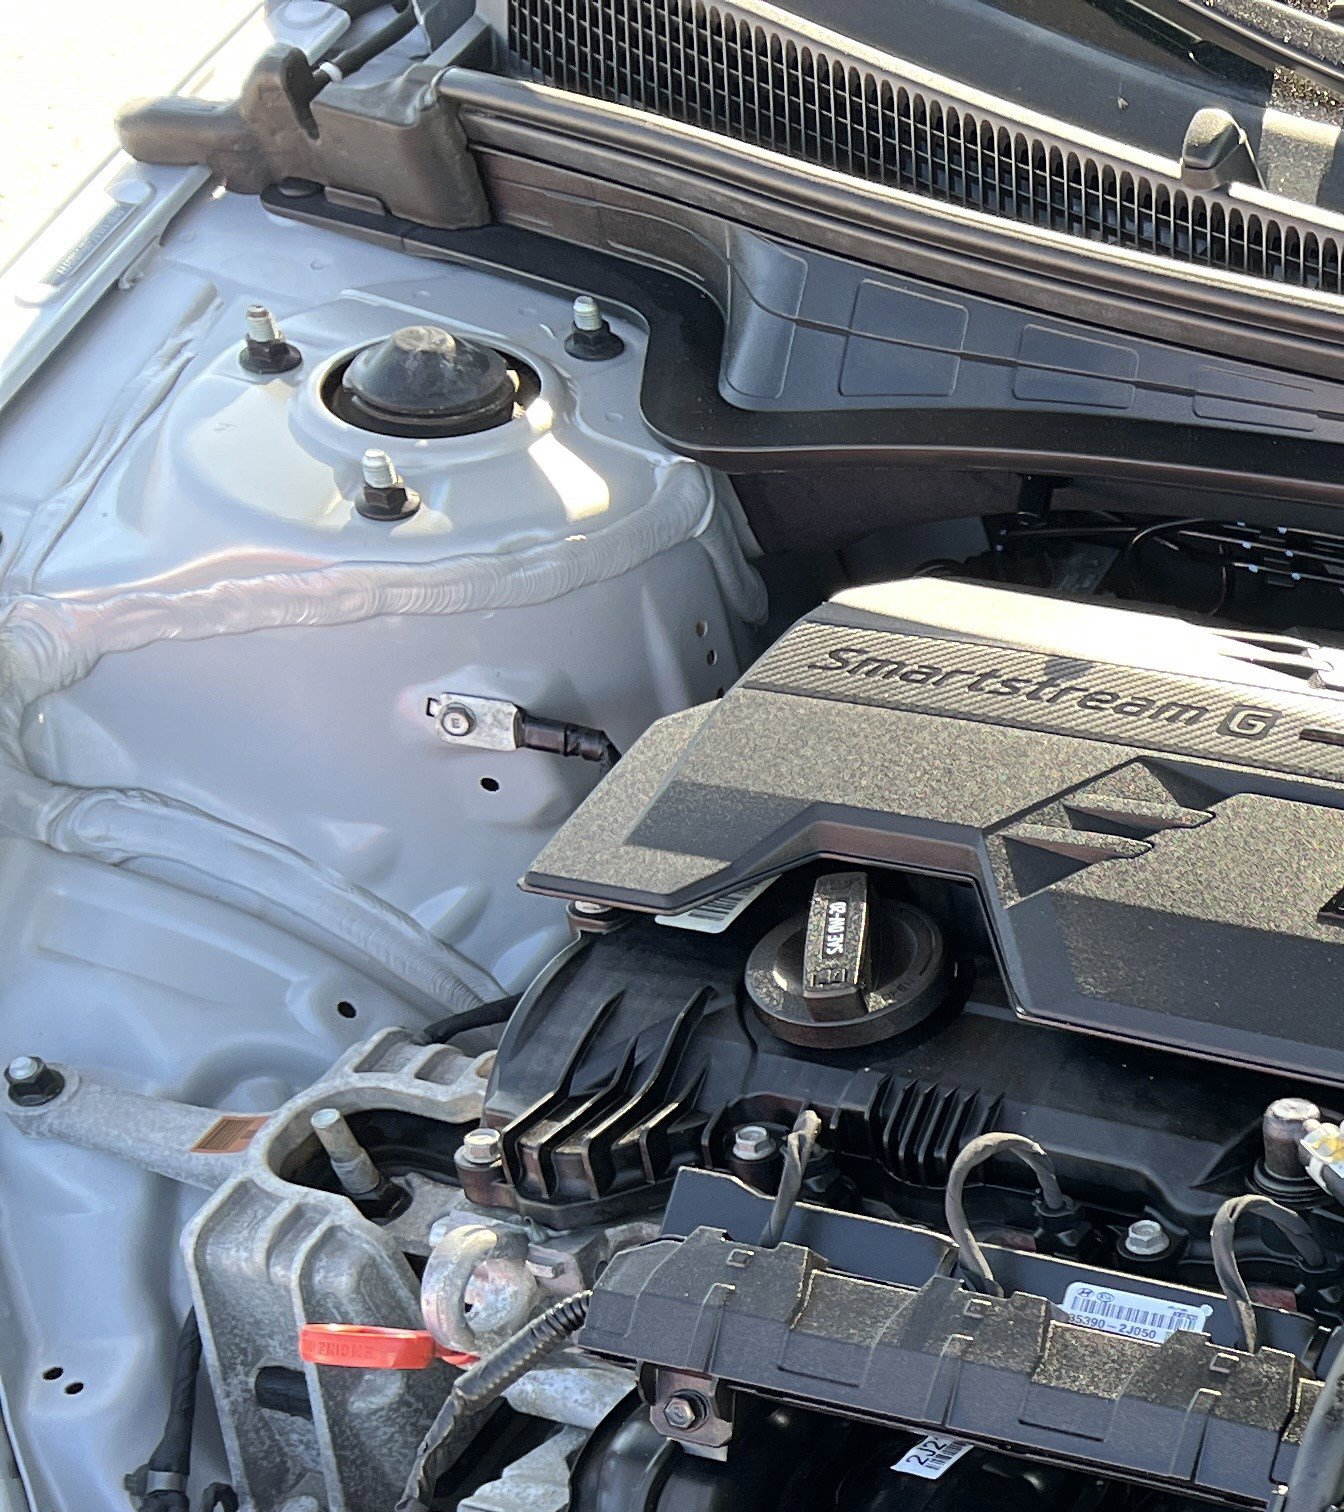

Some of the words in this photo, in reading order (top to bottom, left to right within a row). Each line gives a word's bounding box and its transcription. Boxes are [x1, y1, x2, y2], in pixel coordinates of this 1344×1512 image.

[806, 647, 1210, 726] Smartstream
[827, 901, 847, 934] 0W-20
[826, 934, 844, 955] SAE
